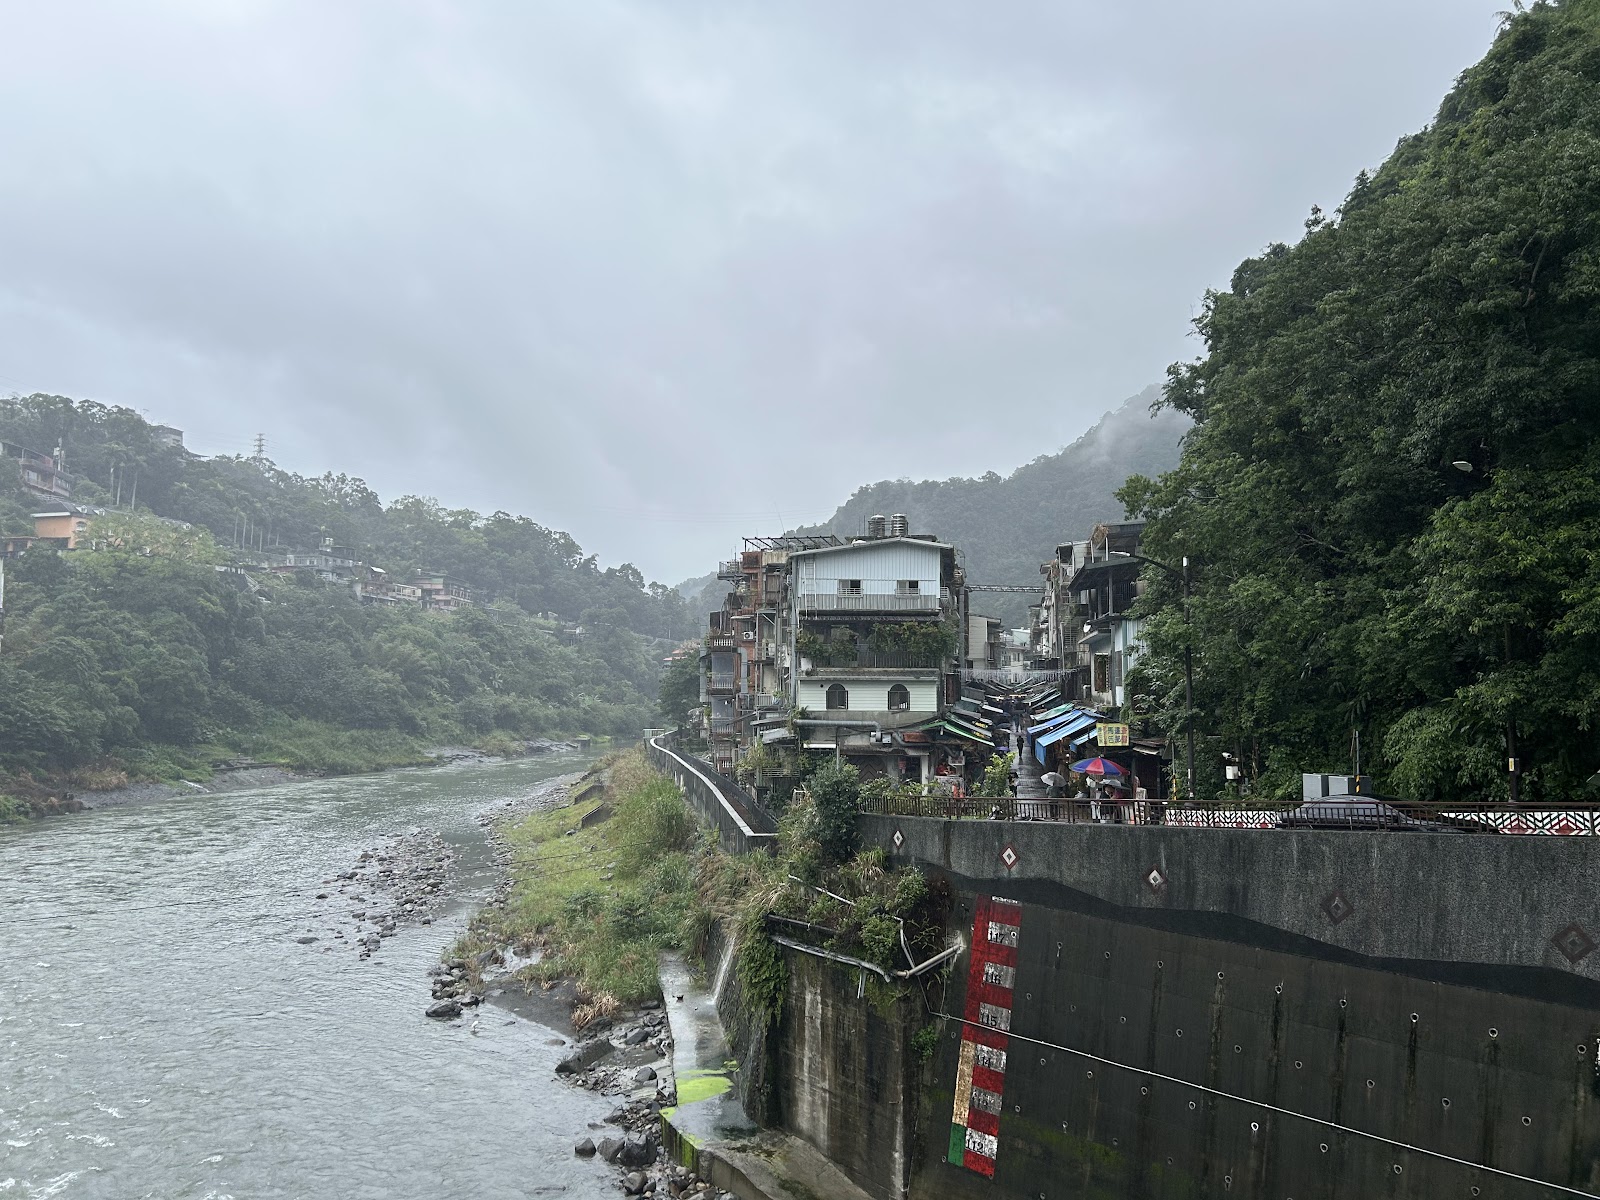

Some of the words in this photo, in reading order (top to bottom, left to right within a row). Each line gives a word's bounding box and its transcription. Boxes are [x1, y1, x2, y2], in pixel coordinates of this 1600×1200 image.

[988, 931, 1006, 943] 117
[985, 972, 1001, 984] 116
[980, 1013, 997, 1026] 115
[965, 1140, 984, 1153] 112
